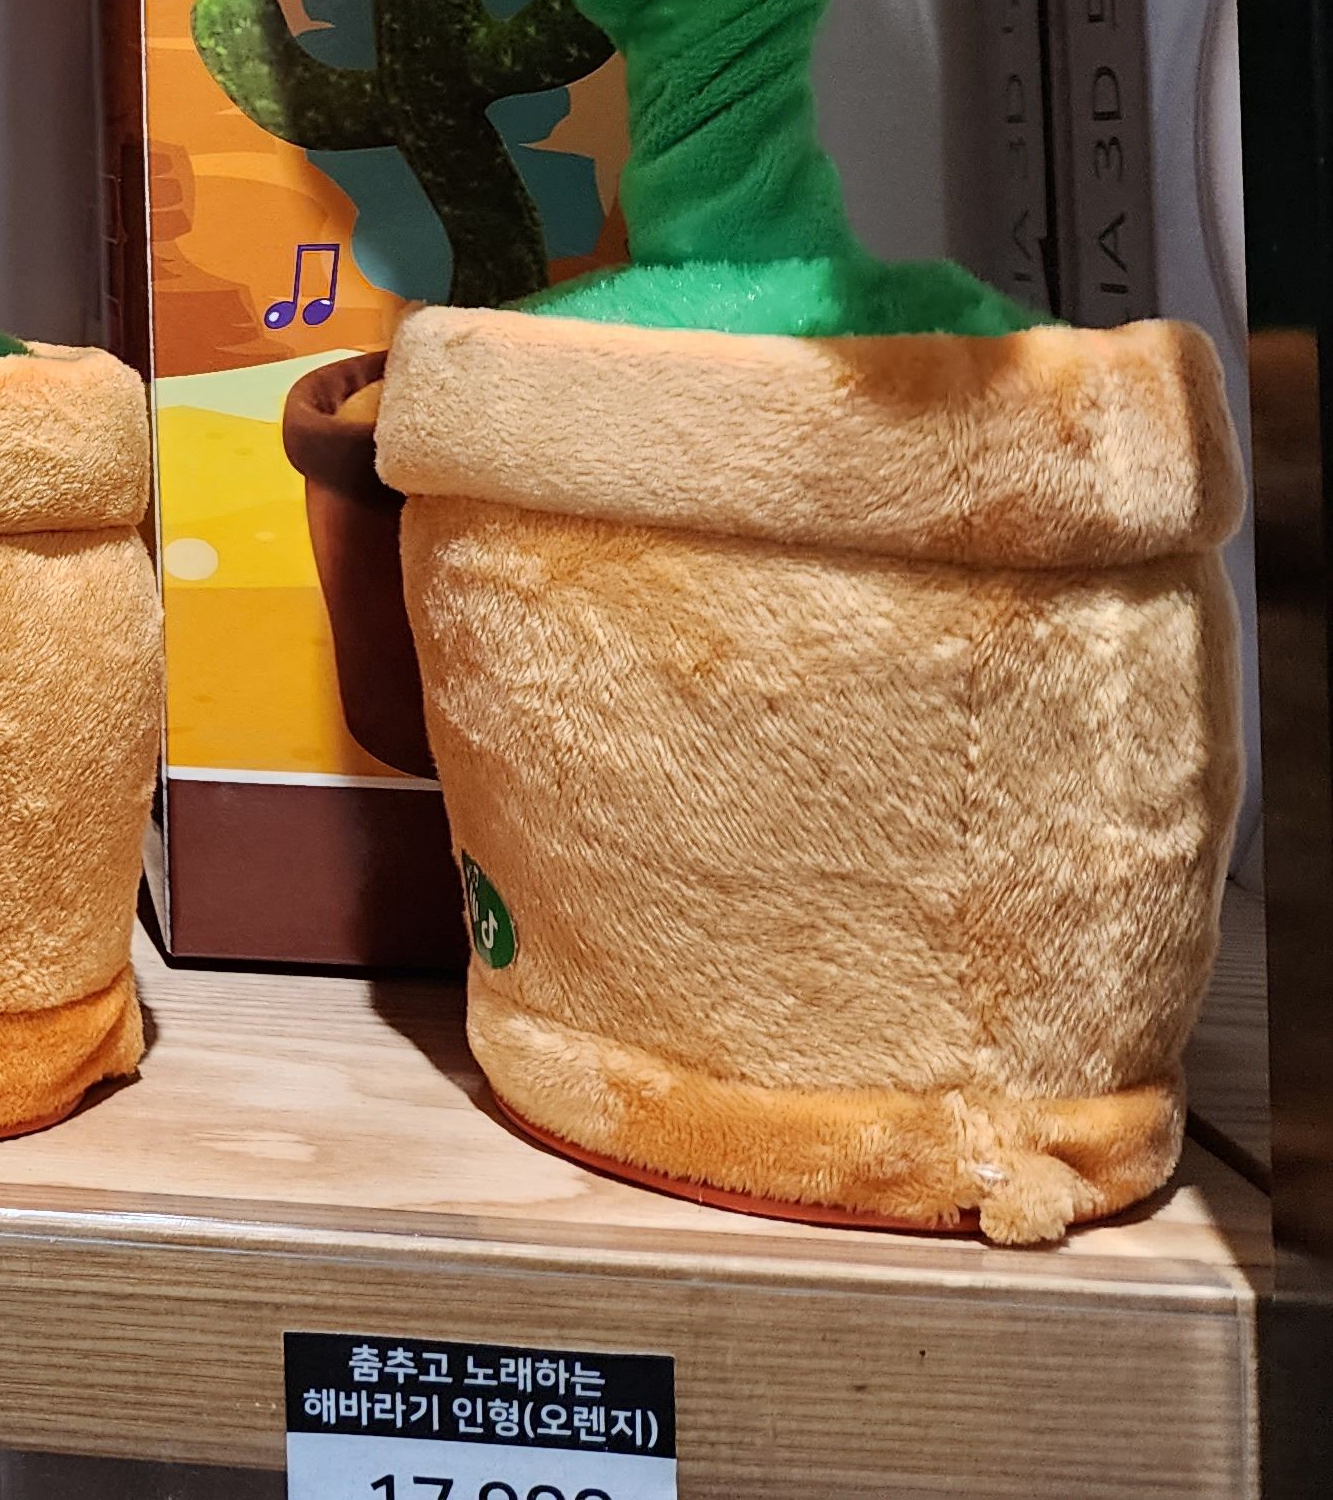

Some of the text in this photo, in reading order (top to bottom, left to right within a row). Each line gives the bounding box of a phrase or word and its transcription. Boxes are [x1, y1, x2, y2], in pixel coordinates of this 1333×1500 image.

[1093, 65, 1122, 179] 3D
[348, 1343, 606, 1398] 춤추고 노래하는
[303, 1388, 440, 1431] 해바라기
